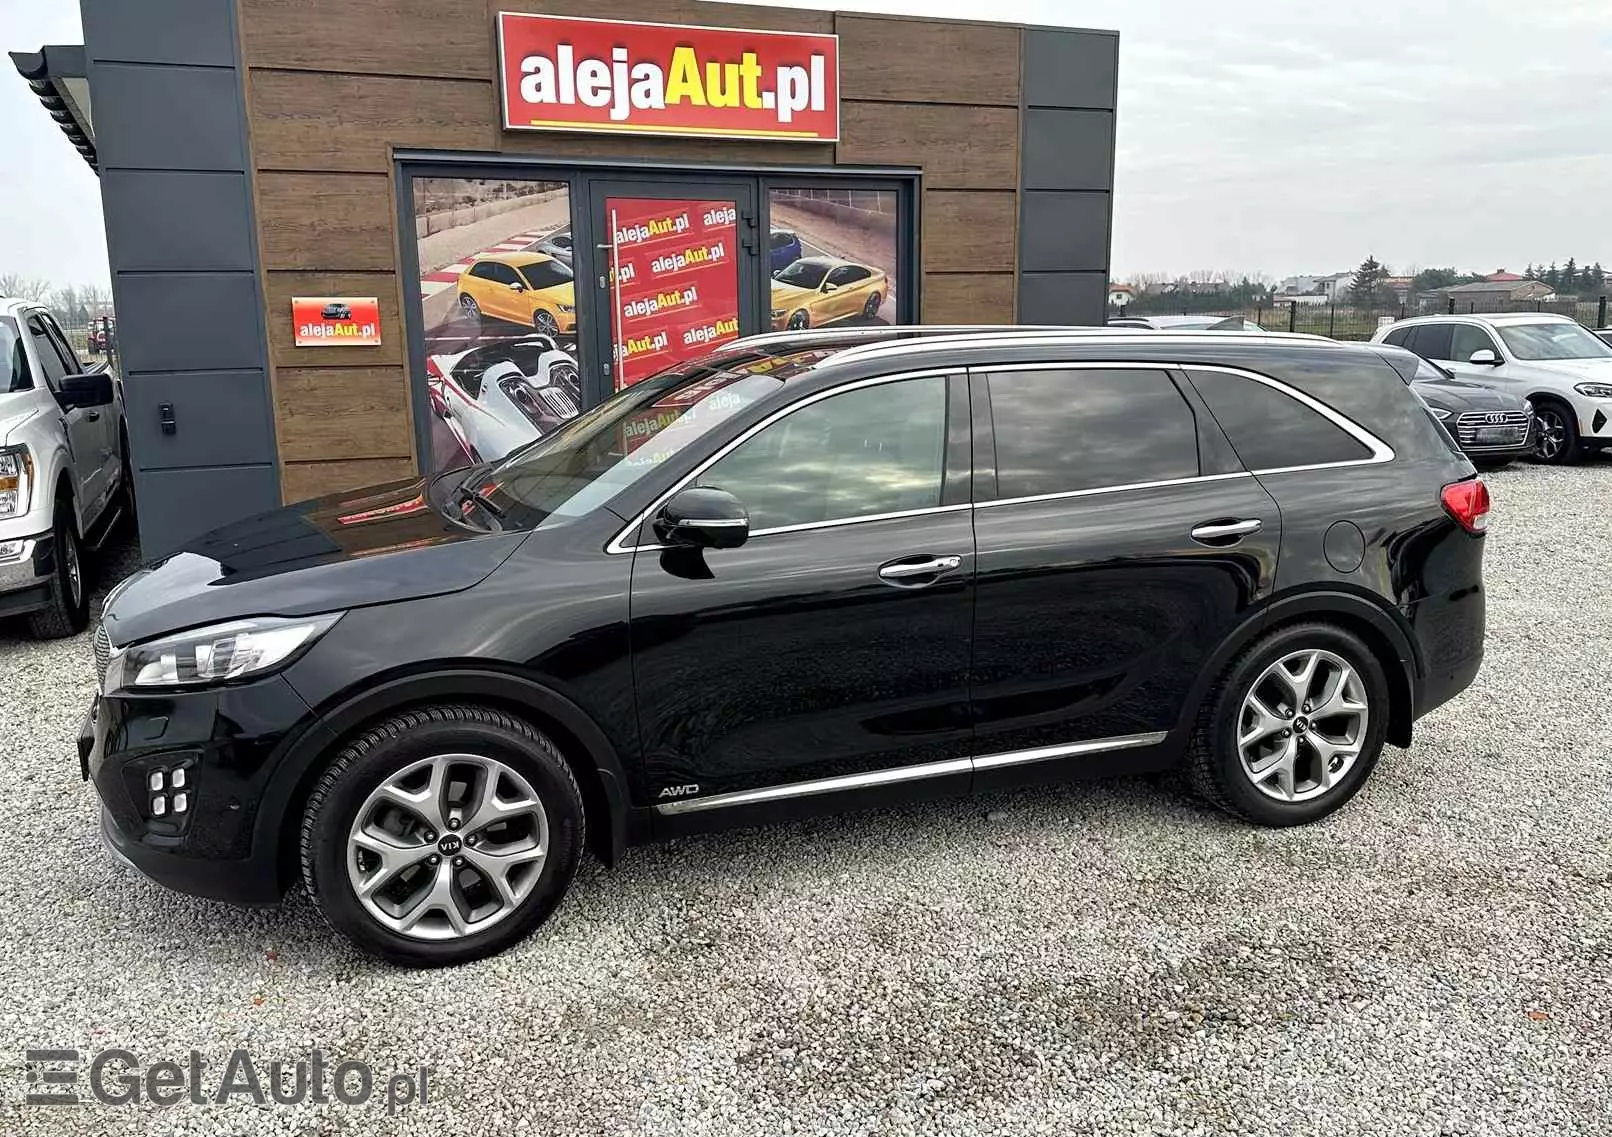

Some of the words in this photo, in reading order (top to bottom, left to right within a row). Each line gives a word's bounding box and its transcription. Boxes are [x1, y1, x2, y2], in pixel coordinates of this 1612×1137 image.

[520, 44, 825, 122] alejaAut.pl
[616, 214, 689, 243] alejaAut.pl
[703, 206, 736, 226] aleja
[651, 242, 724, 273] alejaAut.pl
[624, 286, 698, 317] alejaAut.pl
[300, 323, 375, 338] alejaAut.pl
[683, 318, 738, 344] alejaAut
[658, 784, 699, 798] AWD
[441, 841, 459, 850] KIA
